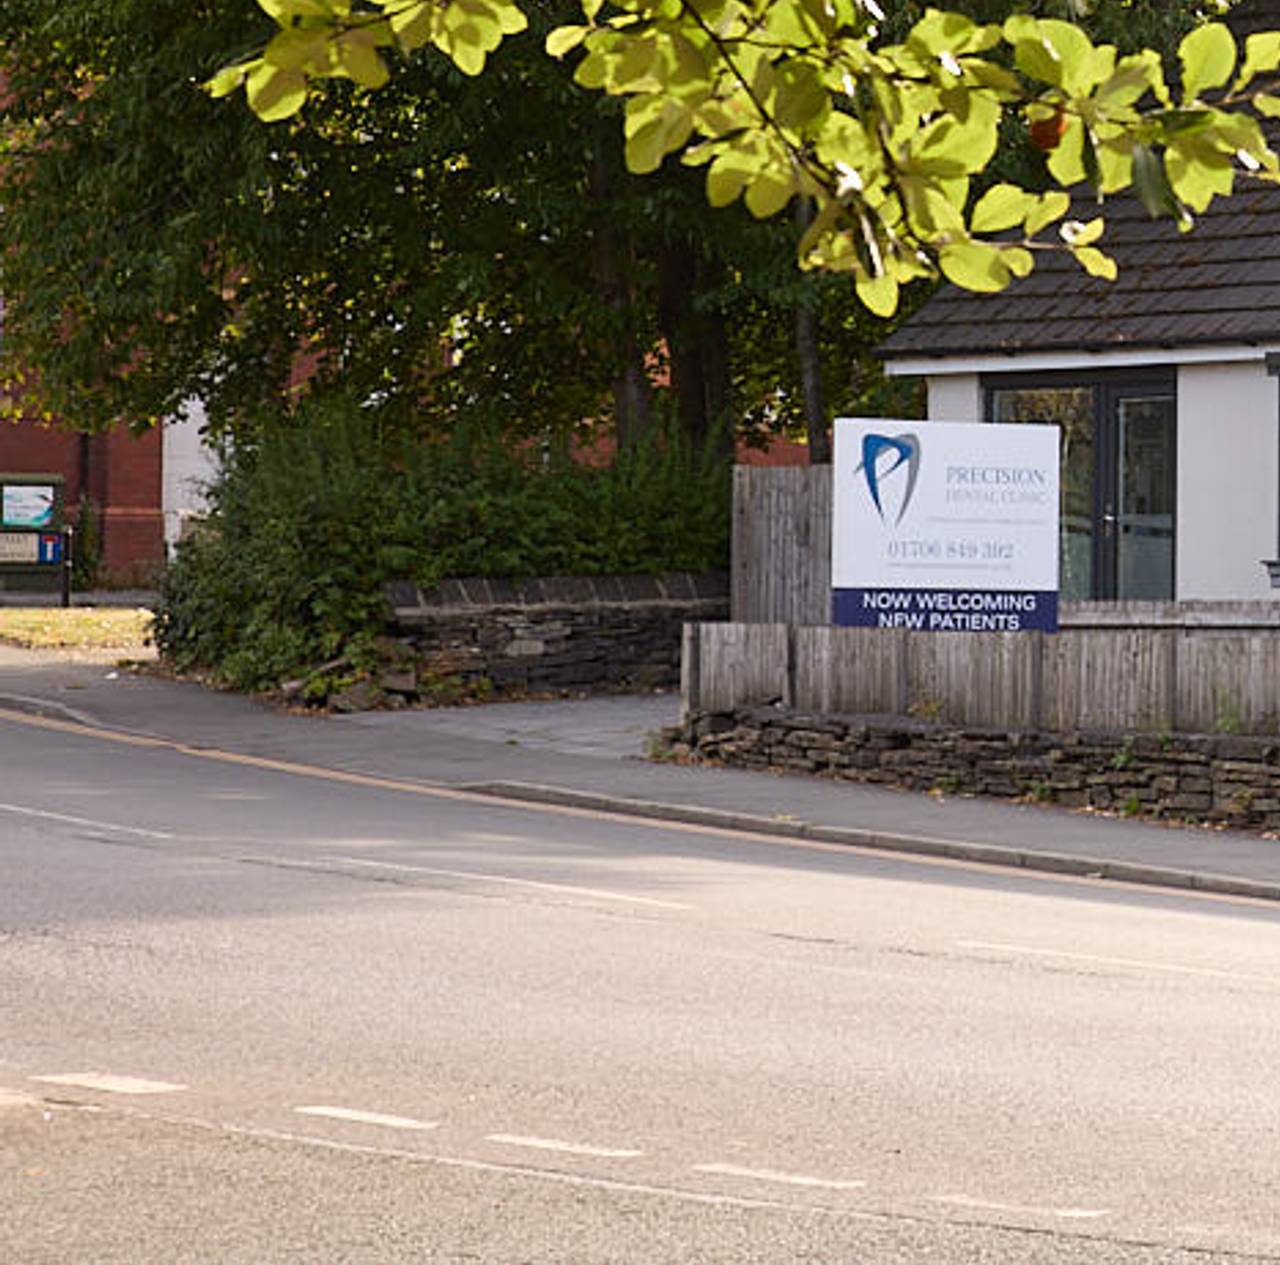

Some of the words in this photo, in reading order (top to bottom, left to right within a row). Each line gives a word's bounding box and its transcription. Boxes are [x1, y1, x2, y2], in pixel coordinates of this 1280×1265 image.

[946, 465, 1047, 486] PRECISION
[863, 593, 912, 609] NOW
[916, 593, 1036, 611] WELCOMING
[878, 613, 924, 629] NEW
[929, 614, 1020, 630] PATIENTS
